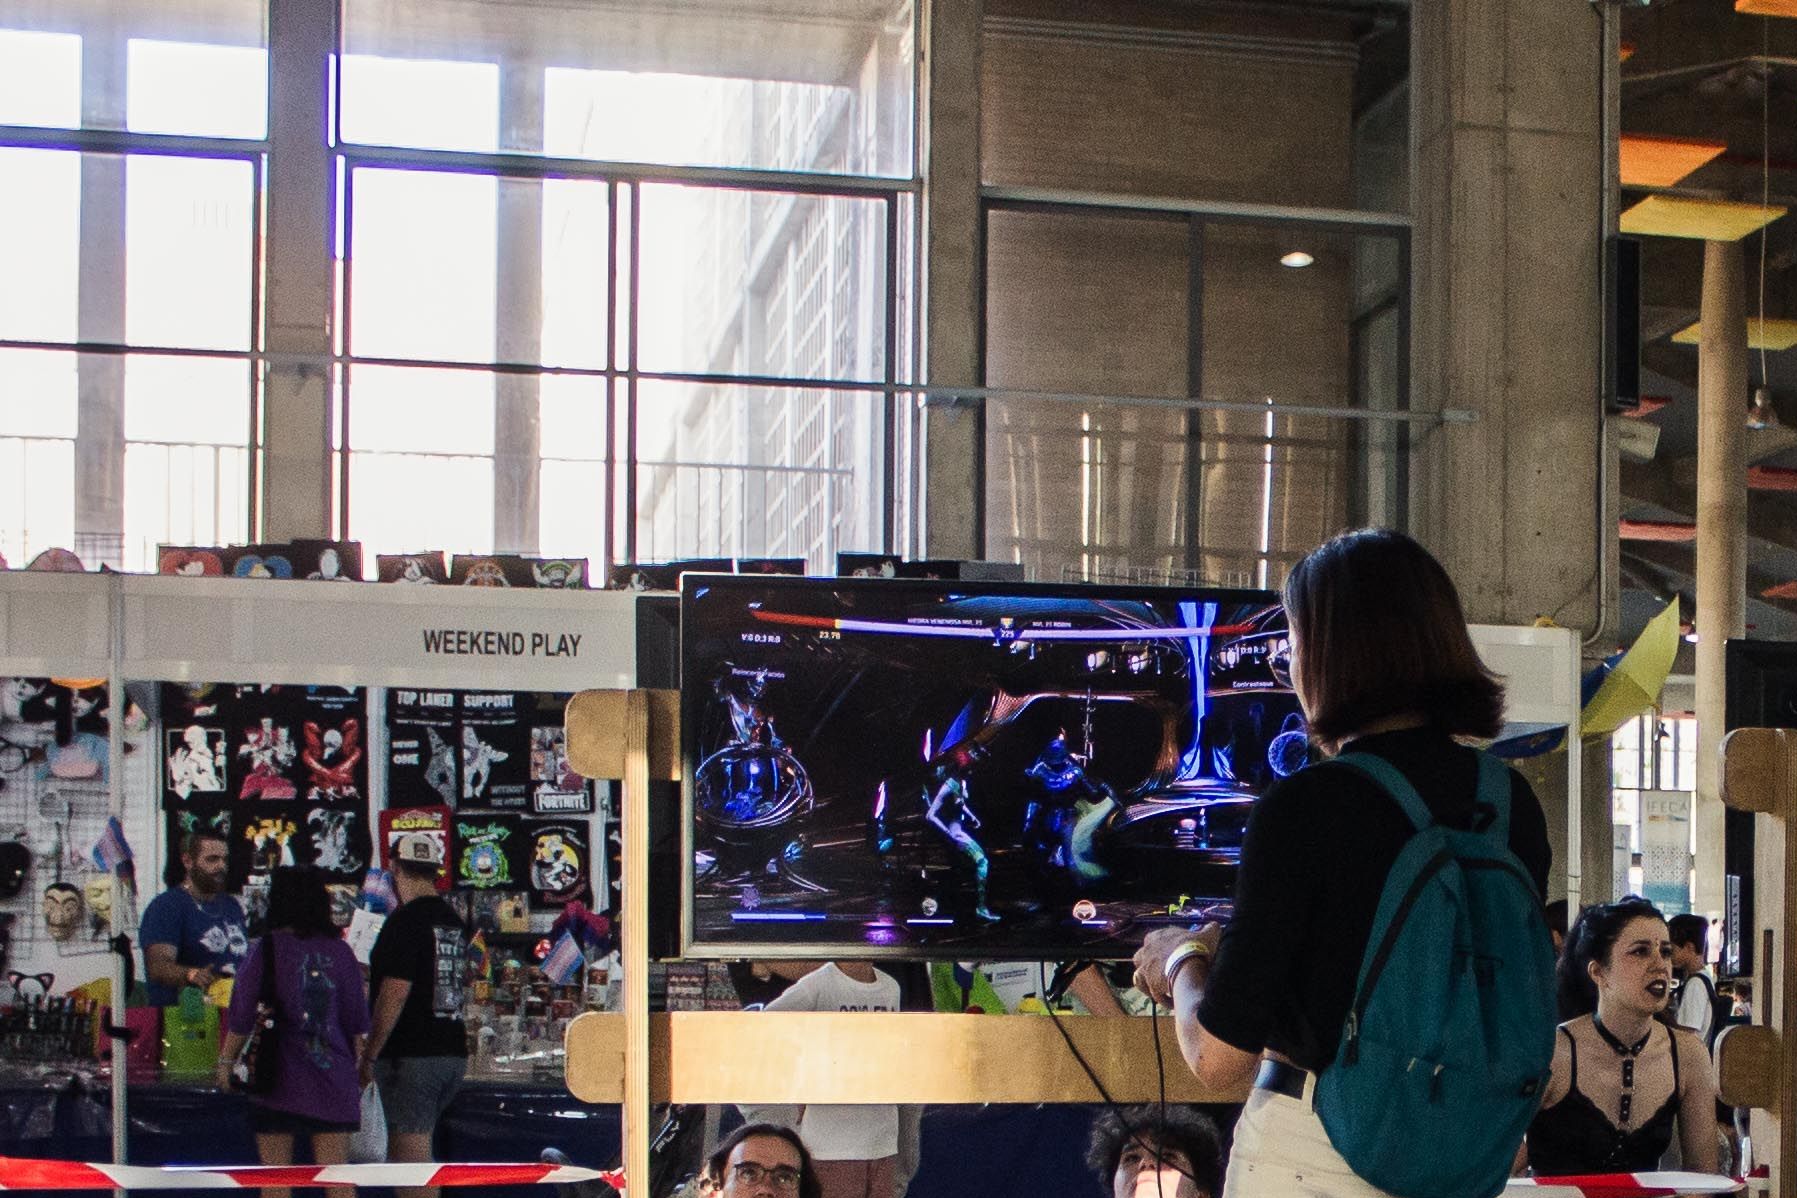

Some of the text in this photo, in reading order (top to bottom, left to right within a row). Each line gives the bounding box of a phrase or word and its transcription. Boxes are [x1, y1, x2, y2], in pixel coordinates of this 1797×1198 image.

[424, 630, 582, 657] WEEKEND PLAY
[397, 690, 417, 706] TOP
[463, 694, 514, 708] SUPPORT
